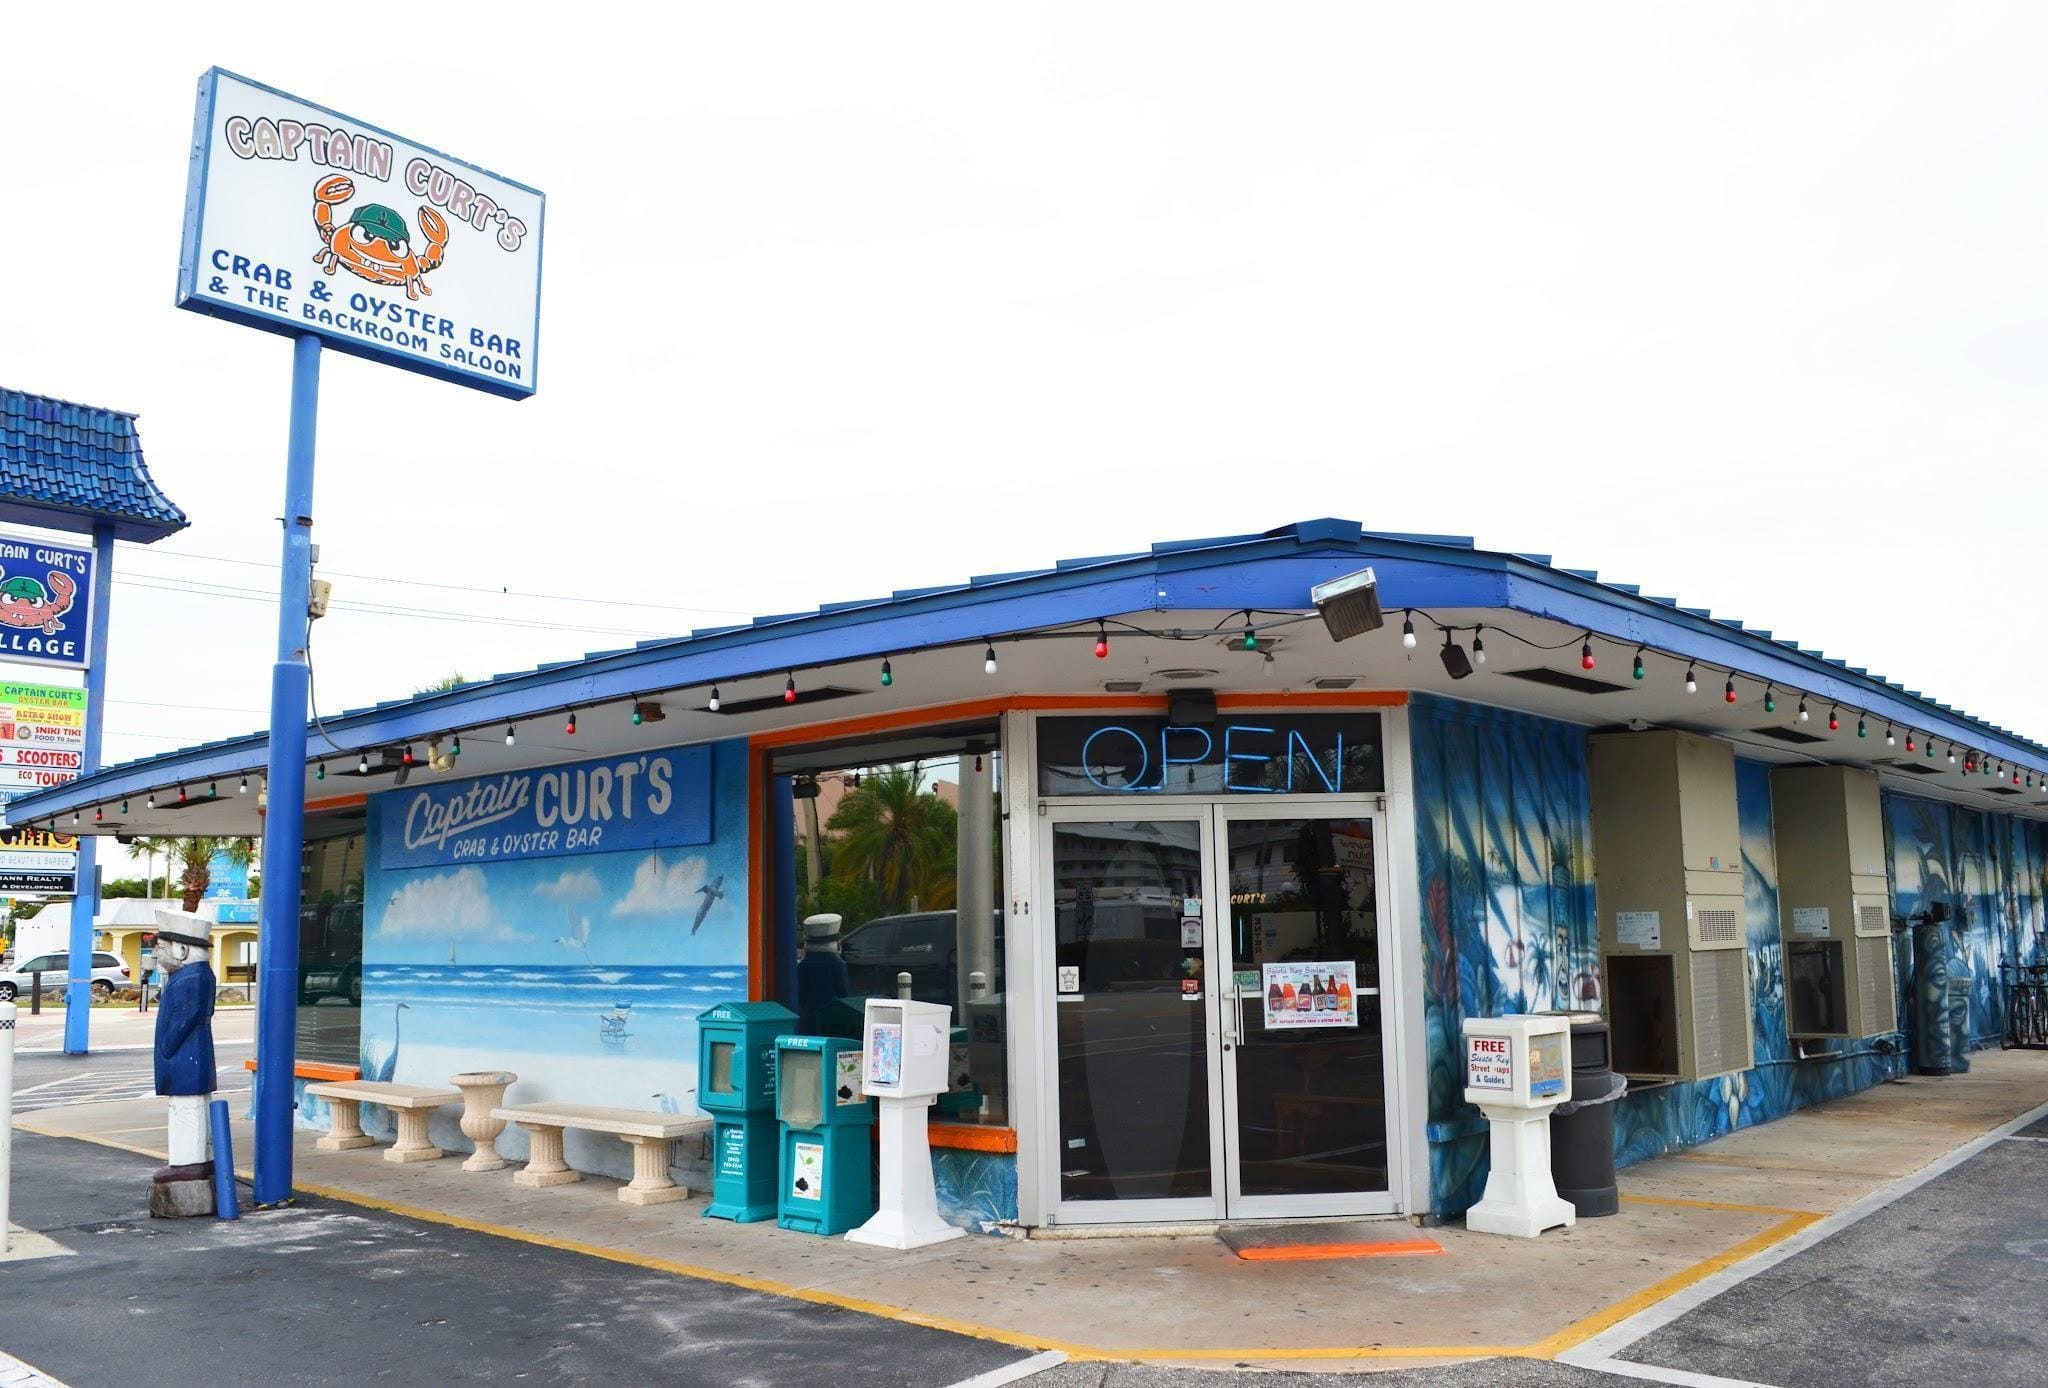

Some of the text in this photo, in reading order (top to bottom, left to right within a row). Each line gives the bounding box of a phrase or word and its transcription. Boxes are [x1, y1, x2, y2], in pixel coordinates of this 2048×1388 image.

[225, 115, 527, 252] CAPTAIN CURT'S
[211, 249, 521, 359] CRAB & OYSTER BAR
[208, 276, 521, 380] & THE BACKROOM SALOON
[35, 549, 86, 575] CURT'S
[4, 686, 82, 701] CAPTAIN CURT'S
[18, 696, 68, 707] OYSTER BAR
[16, 709, 45, 719] RETRO
[47, 712, 72, 722] SHOW
[35, 726, 81, 736] SNIKI TIKI
[16, 750, 77, 767] SCOOTERS
[1081, 725, 1343, 794] OPEN
[18, 770, 32, 780] ECO
[404, 756, 673, 850] Captain CURT'S
[453, 827, 602, 860] CRAB & OYSTER BAR
[9, 856, 33, 865] BEAUTY
[44, 857, 70, 866] BARBER
[1230, 893, 1267, 905] CURT'S
[1289, 967, 1303, 975] Key
[1305, 966, 1326, 974] Sodas
[712, 1010, 732, 1019] FREE
[787, 1037, 809, 1047] FREE
[1474, 1040, 1505, 1053] FREE
[1471, 1053, 1509, 1065] Siesta Key
[1470, 1063, 1490, 1072] Street
[1475, 1074, 1505, 1084] & Guides
